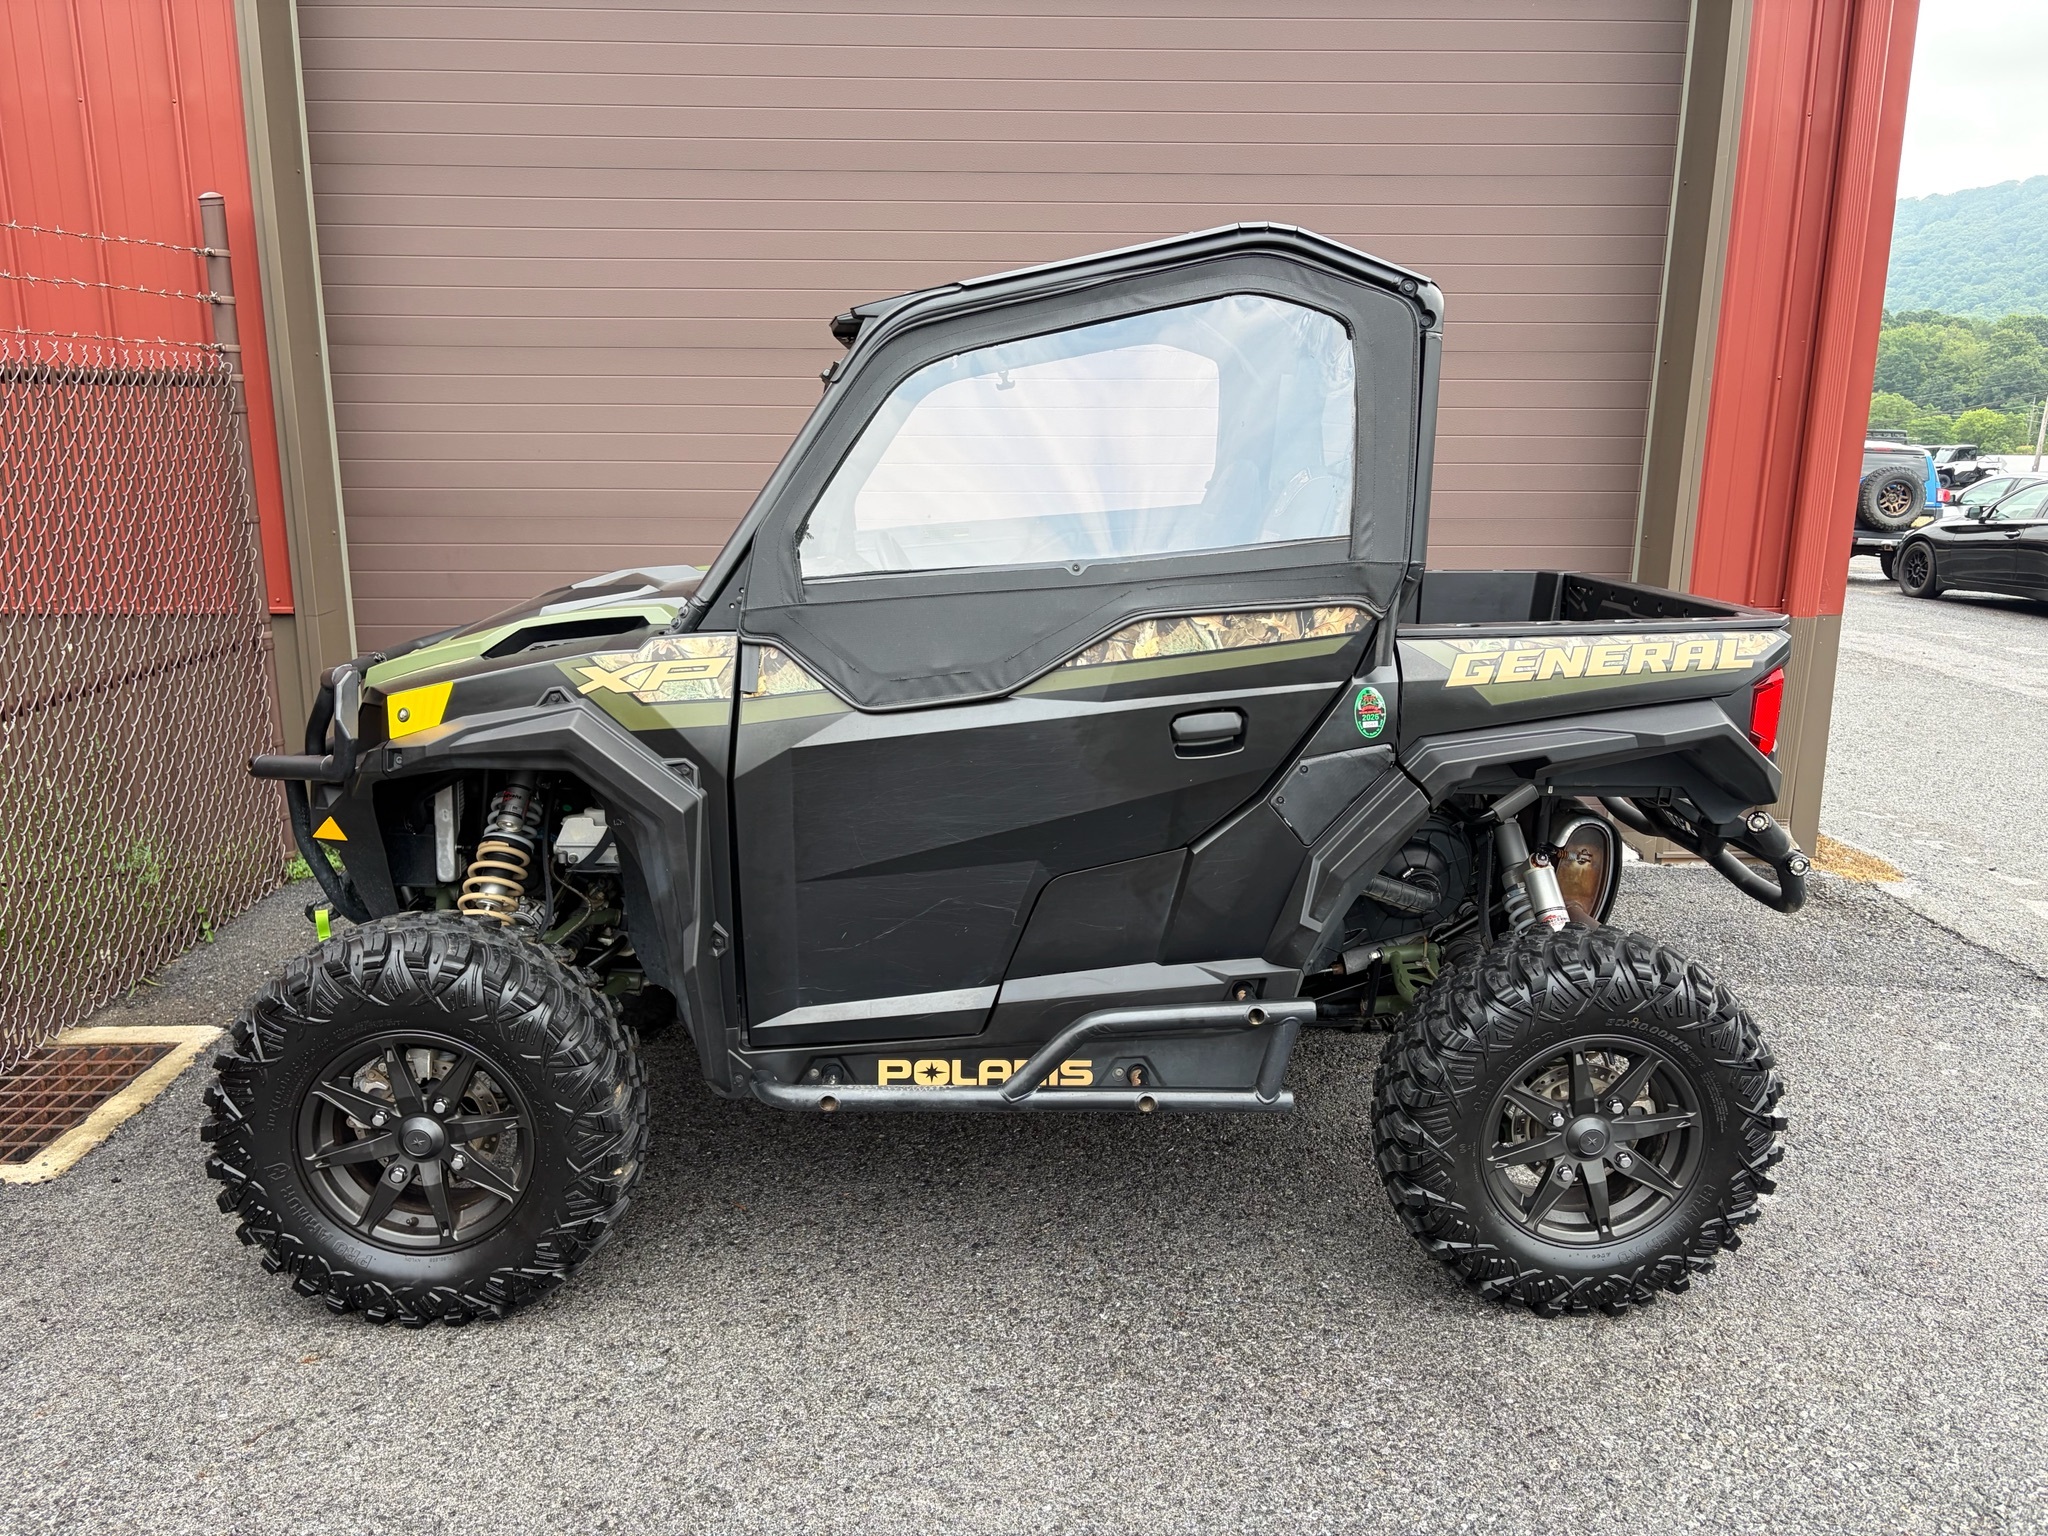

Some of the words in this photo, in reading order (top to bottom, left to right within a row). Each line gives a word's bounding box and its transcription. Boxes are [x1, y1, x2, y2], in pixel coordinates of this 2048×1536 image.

[574, 656, 732, 695] XP
[1445, 638, 1754, 687] GENERAL
[878, 1059, 1094, 1086] POLAIS
[332, 1240, 373, 1269] PRO
